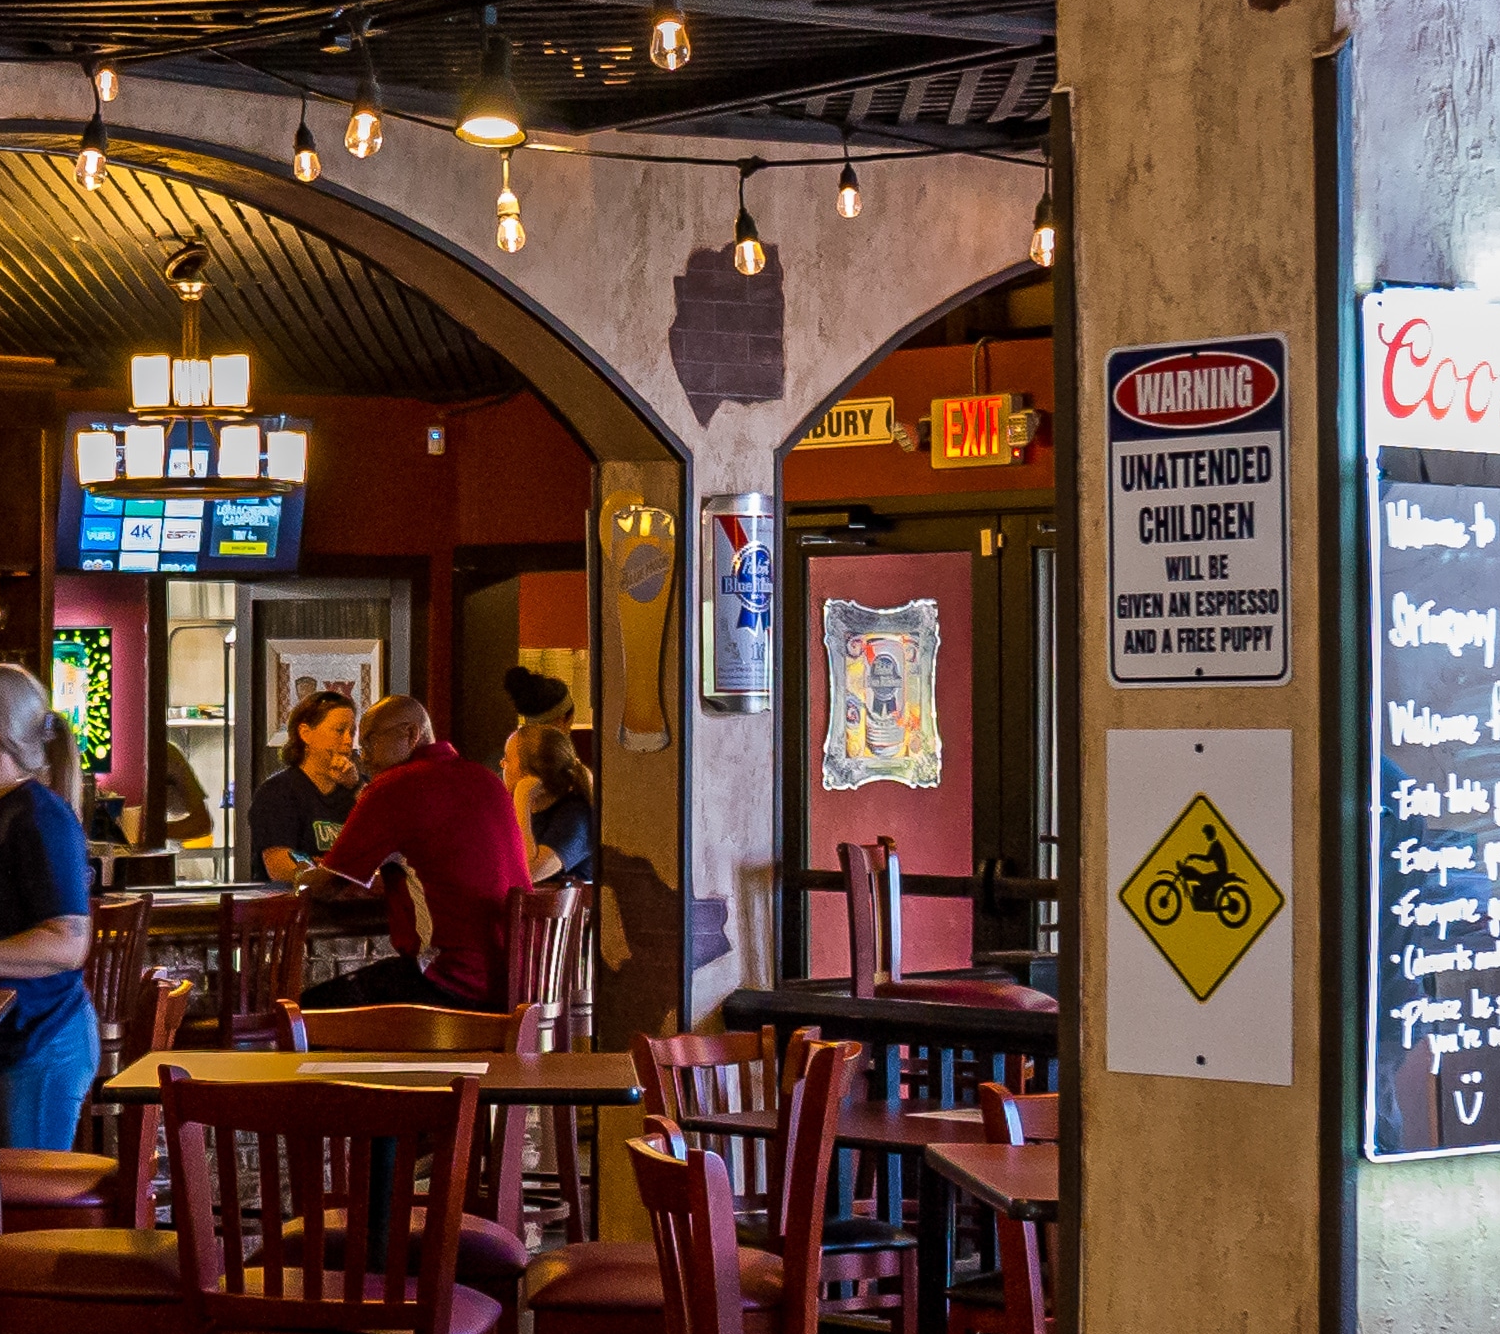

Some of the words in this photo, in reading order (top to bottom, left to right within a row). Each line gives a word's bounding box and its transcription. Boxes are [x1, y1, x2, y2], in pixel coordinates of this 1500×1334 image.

[1136, 364, 1253, 416] WARNING
[806, 408, 874, 440] BURY
[944, 396, 1002, 458] EXIT
[1120, 445, 1272, 492] UNATTENDED
[130, 524, 152, 539] 4K
[1139, 501, 1255, 544] CHILDREN
[1166, 556, 1204, 582] WILL
[1209, 554, 1229, 580] BE
[1117, 592, 1163, 618] GIVEN
[1168, 591, 1191, 617] AN
[1195, 588, 1279, 616] ESPRESSO
[1124, 629, 1157, 654] AND
[1161, 628, 1173, 653] A
[1177, 627, 1216, 653] FREE
[1220, 625, 1273, 652] PUPPY
